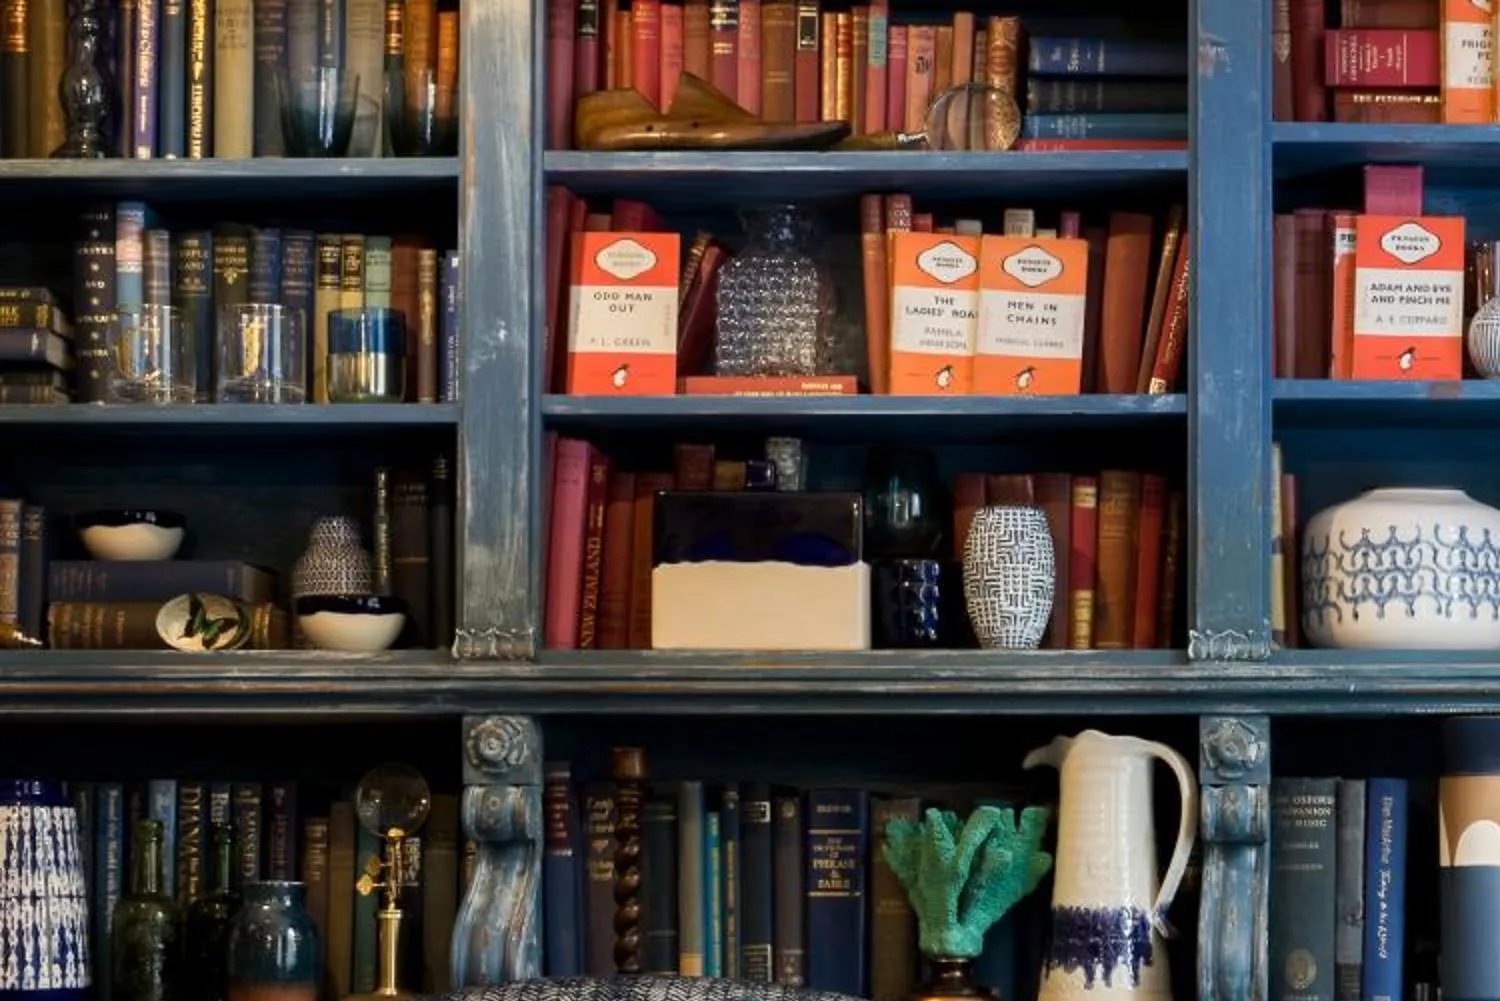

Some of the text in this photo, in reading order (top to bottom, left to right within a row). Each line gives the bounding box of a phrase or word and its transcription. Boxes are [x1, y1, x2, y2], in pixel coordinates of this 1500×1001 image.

[1370, 282, 1452, 293] ADAM AND EVE
[593, 291, 653, 301] ODD MAN
[934, 295, 955, 306] THE
[1371, 295, 1395, 305] AND
[1435, 296, 1451, 305] ME
[609, 303, 635, 313] OUT
[1007, 300, 1058, 312] MEN IN
[1007, 314, 1058, 326] CHAINS
[581, 537, 603, 648] NEW ZEALAND
[1293, 795, 1335, 805] OXFORD
[179, 786, 202, 857] DIANA
